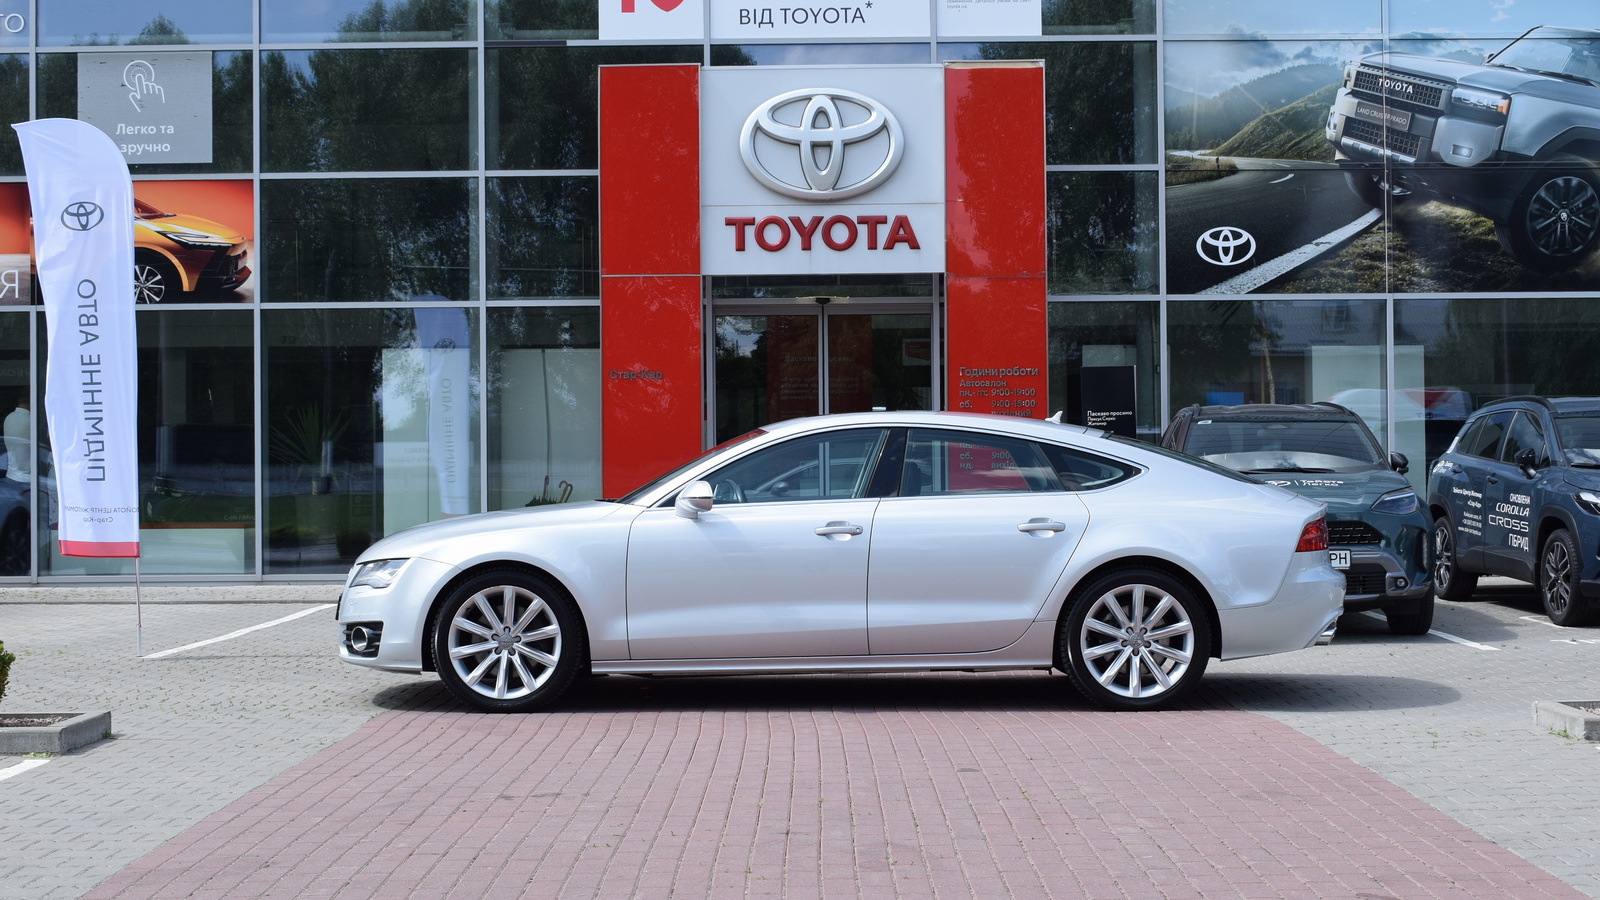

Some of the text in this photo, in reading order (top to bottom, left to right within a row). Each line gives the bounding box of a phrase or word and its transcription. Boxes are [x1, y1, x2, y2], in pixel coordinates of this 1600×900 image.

[739, 8, 774, 28] ВІД
[1378, 79, 1413, 93] TOYOTA
[1356, 106, 1370, 116] LAND
[1390, 114, 1407, 125] PRADO
[115, 123, 175, 135] Легко та
[120, 143, 171, 156] зручно
[725, 214, 921, 252] TOYOTA
[609, 369, 663, 381] Стар-Кар
[959, 365, 1039, 378] Години роботи
[959, 379, 1007, 387] Автосалон
[959, 400, 973, 408] сб.
[960, 451, 973, 460] сб.
[960, 462, 974, 470] нд.
[1510, 493, 1530, 505] ОНОВЛЕНА
[1495, 502, 1530, 517] COROLLA
[1488, 514, 1529, 532] CROSS
[1508, 533, 1529, 552] ГІБРИД
